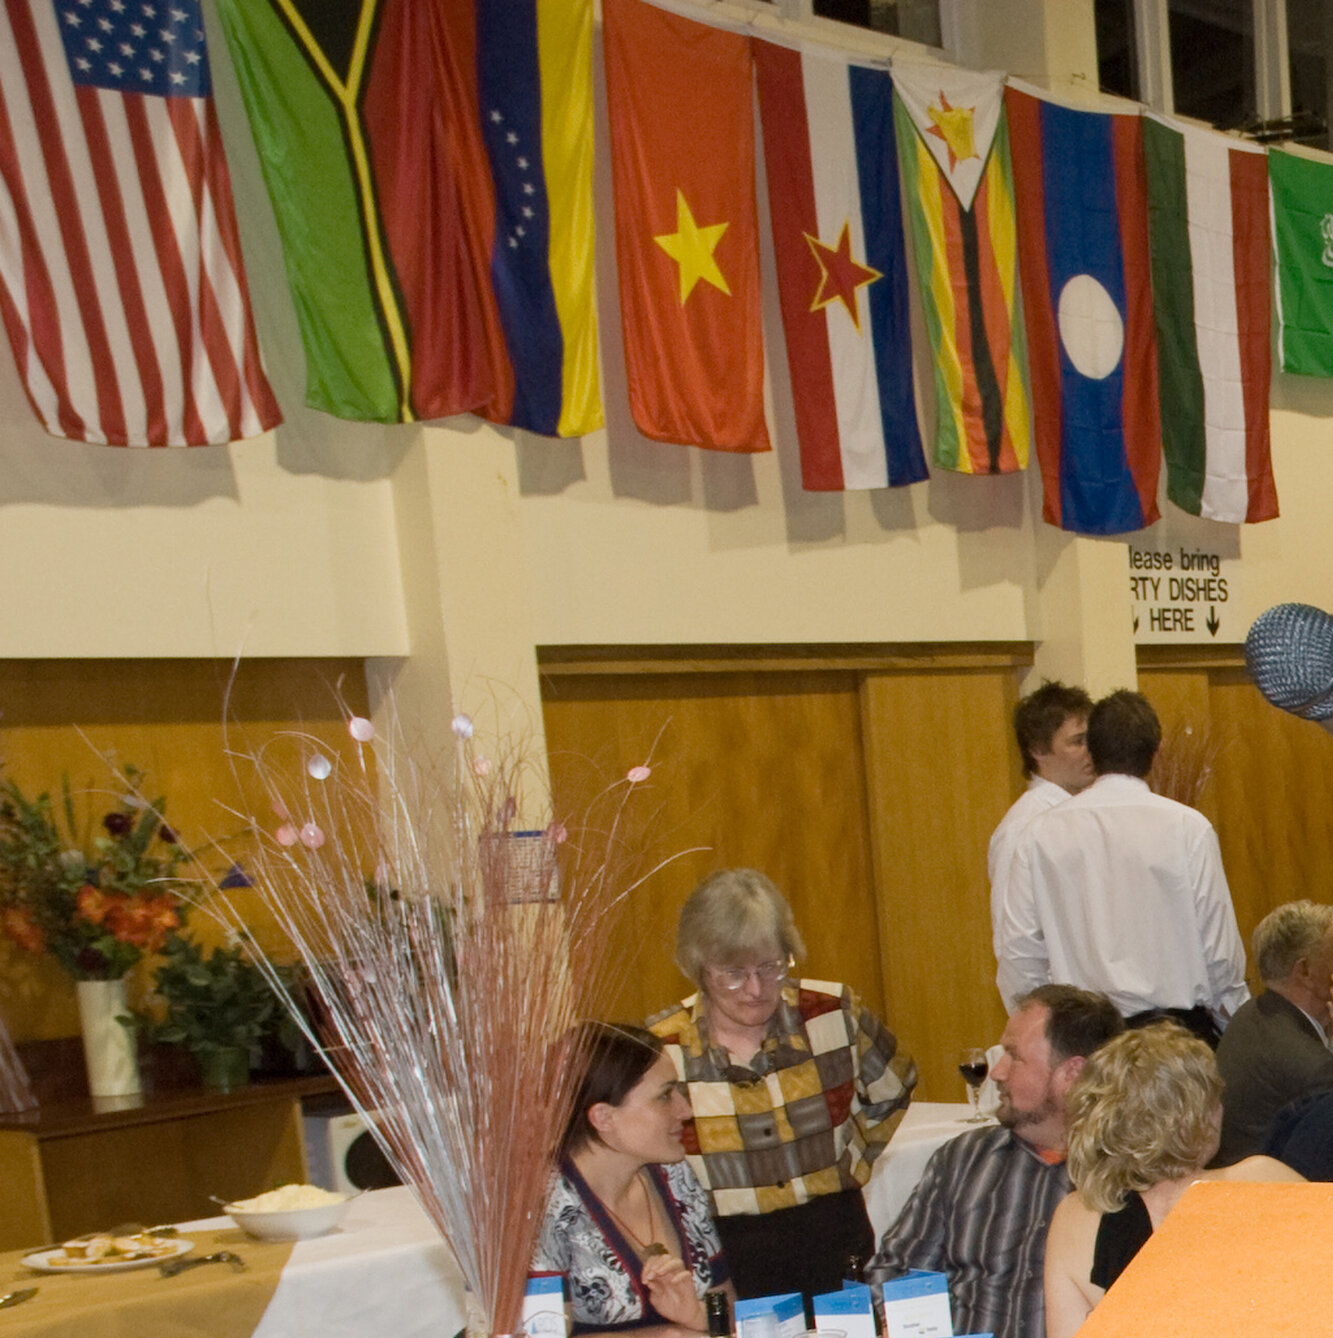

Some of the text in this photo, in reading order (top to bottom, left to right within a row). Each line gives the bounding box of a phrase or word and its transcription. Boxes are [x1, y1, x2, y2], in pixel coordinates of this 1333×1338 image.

[1128, 544, 1220, 577] lease bring
[1130, 576, 1229, 602] RTY DISHES
[1150, 607, 1195, 632] HERE
